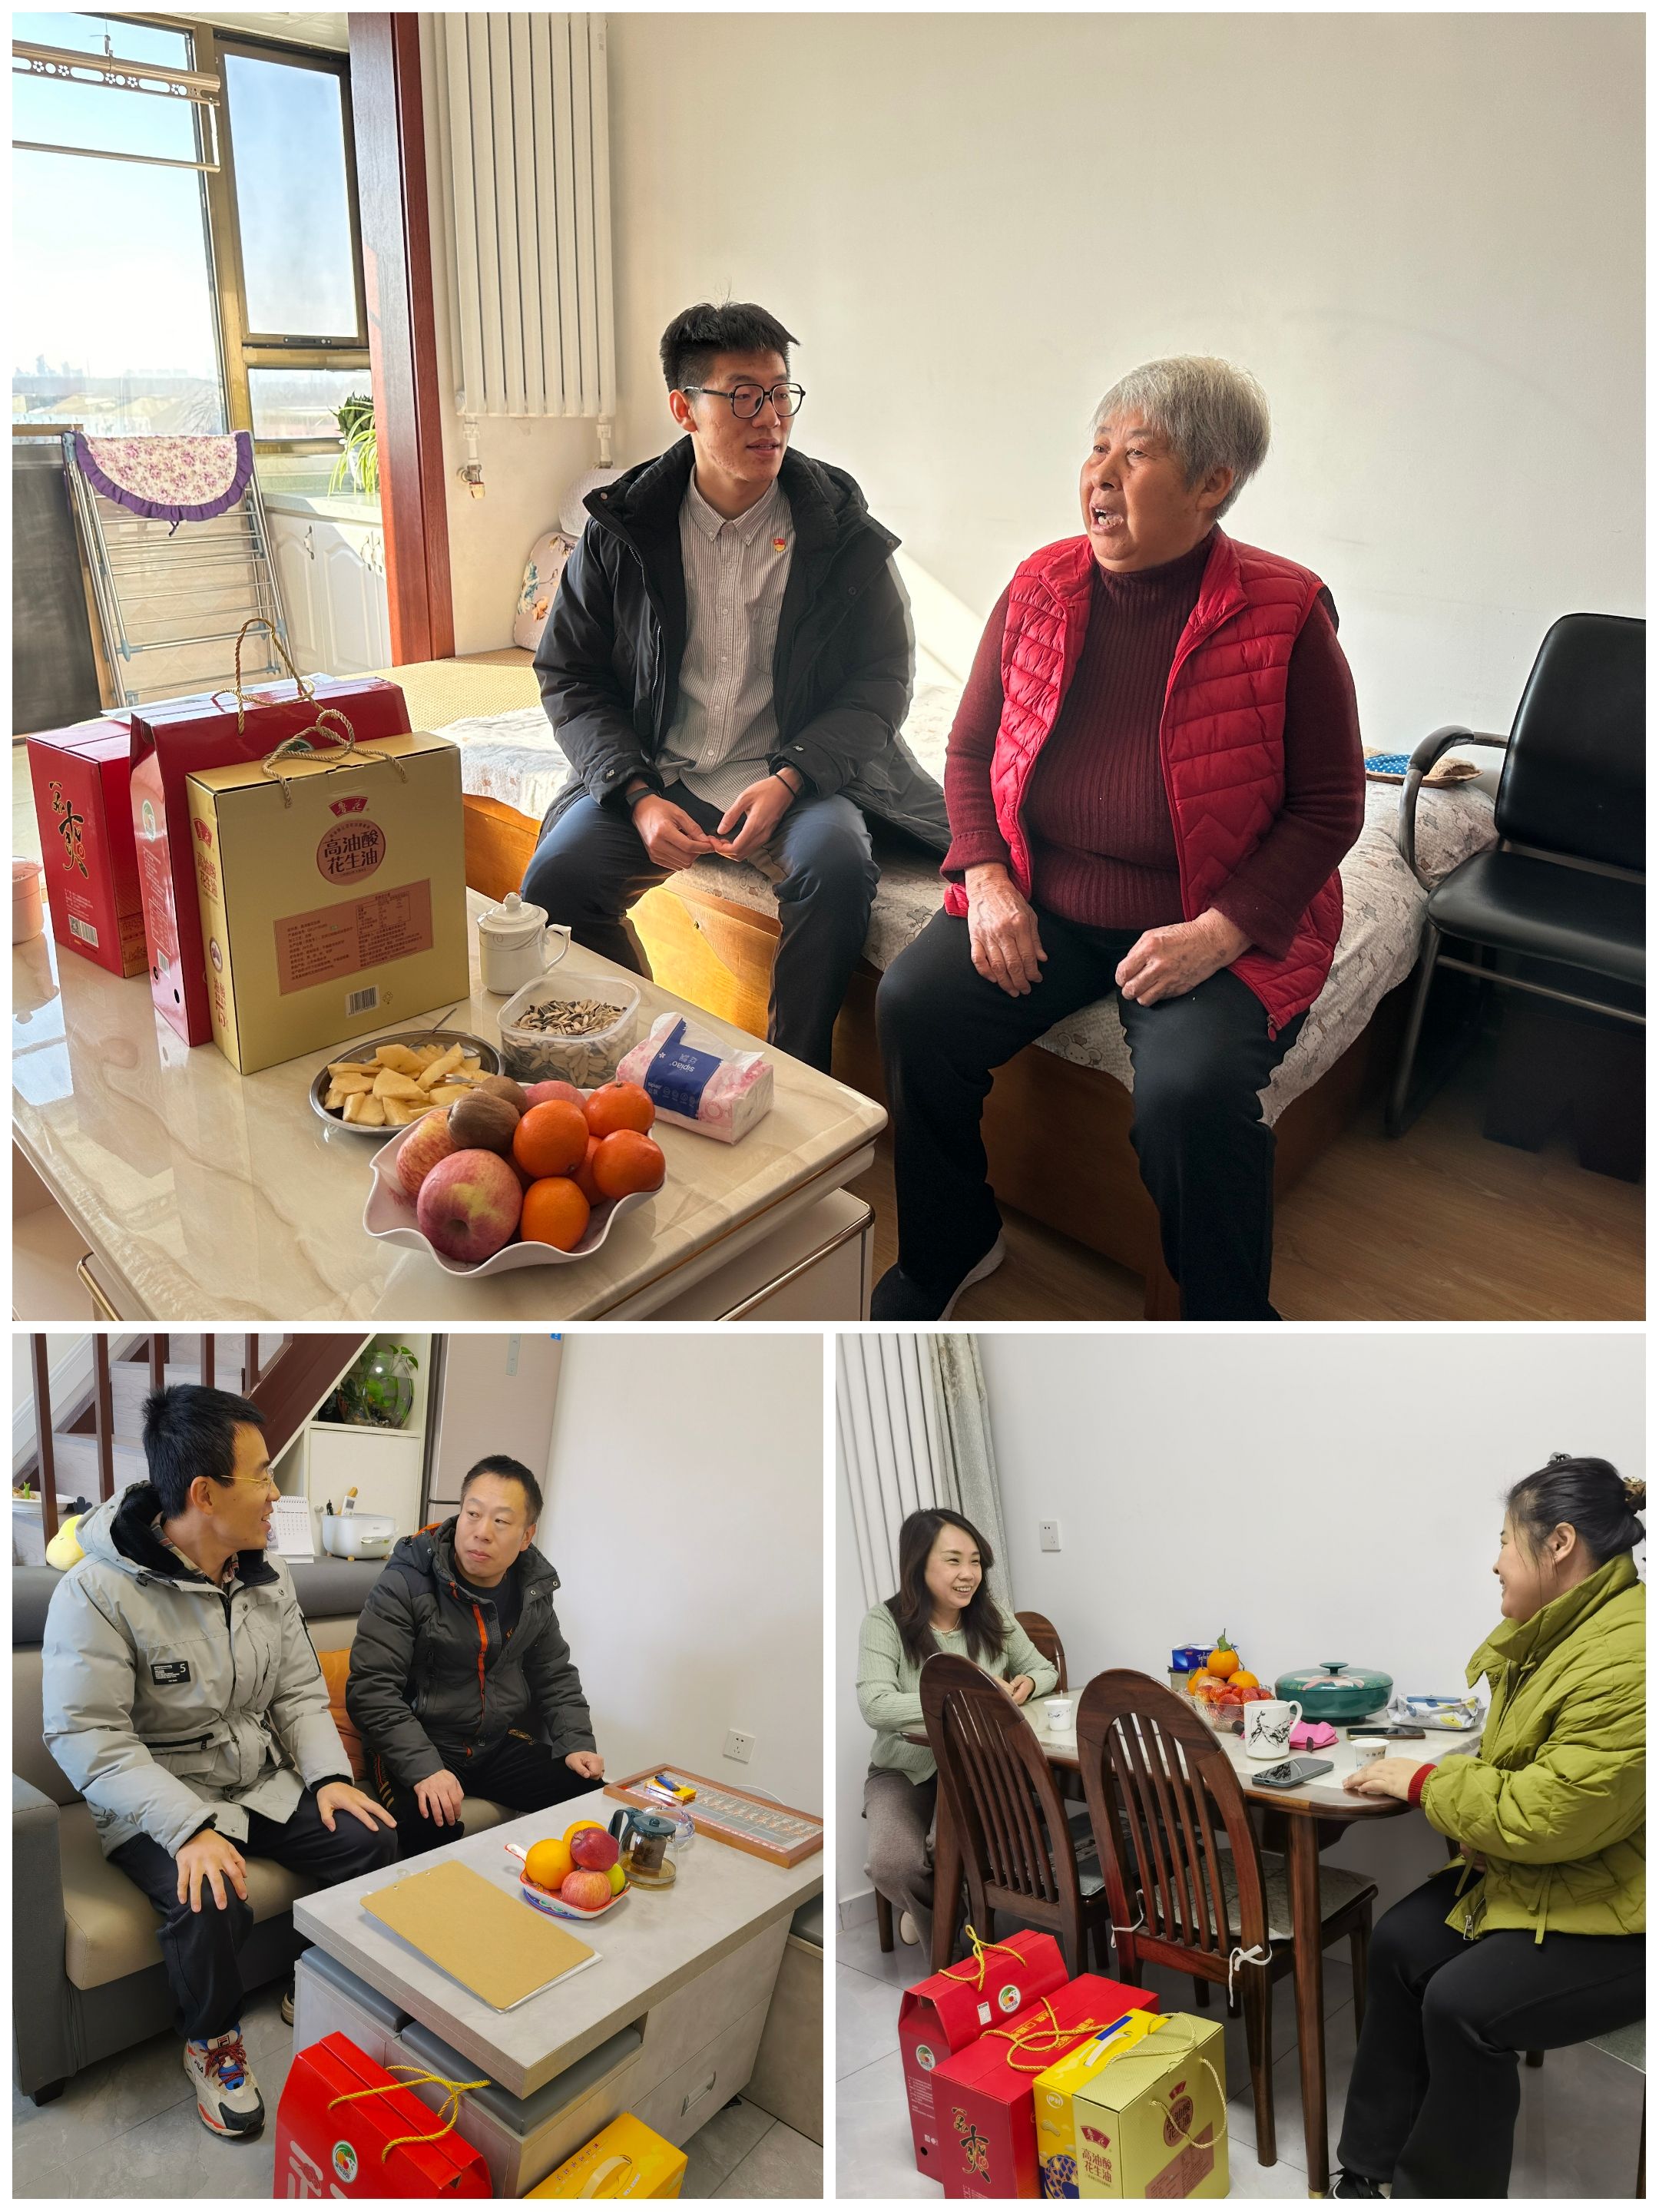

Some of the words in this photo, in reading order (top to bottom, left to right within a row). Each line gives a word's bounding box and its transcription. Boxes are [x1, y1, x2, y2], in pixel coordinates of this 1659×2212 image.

[323, 830, 379, 858] 高油酸
[327, 848, 378, 874] 花生油
[671, 1061, 695, 1073] sipiao
[180, 1663, 186, 1673] 5
[194, 2059, 204, 2074] FILA
[1081, 2147, 1112, 2172] 高油酸
[1084, 2161, 1112, 2183] 花生油
